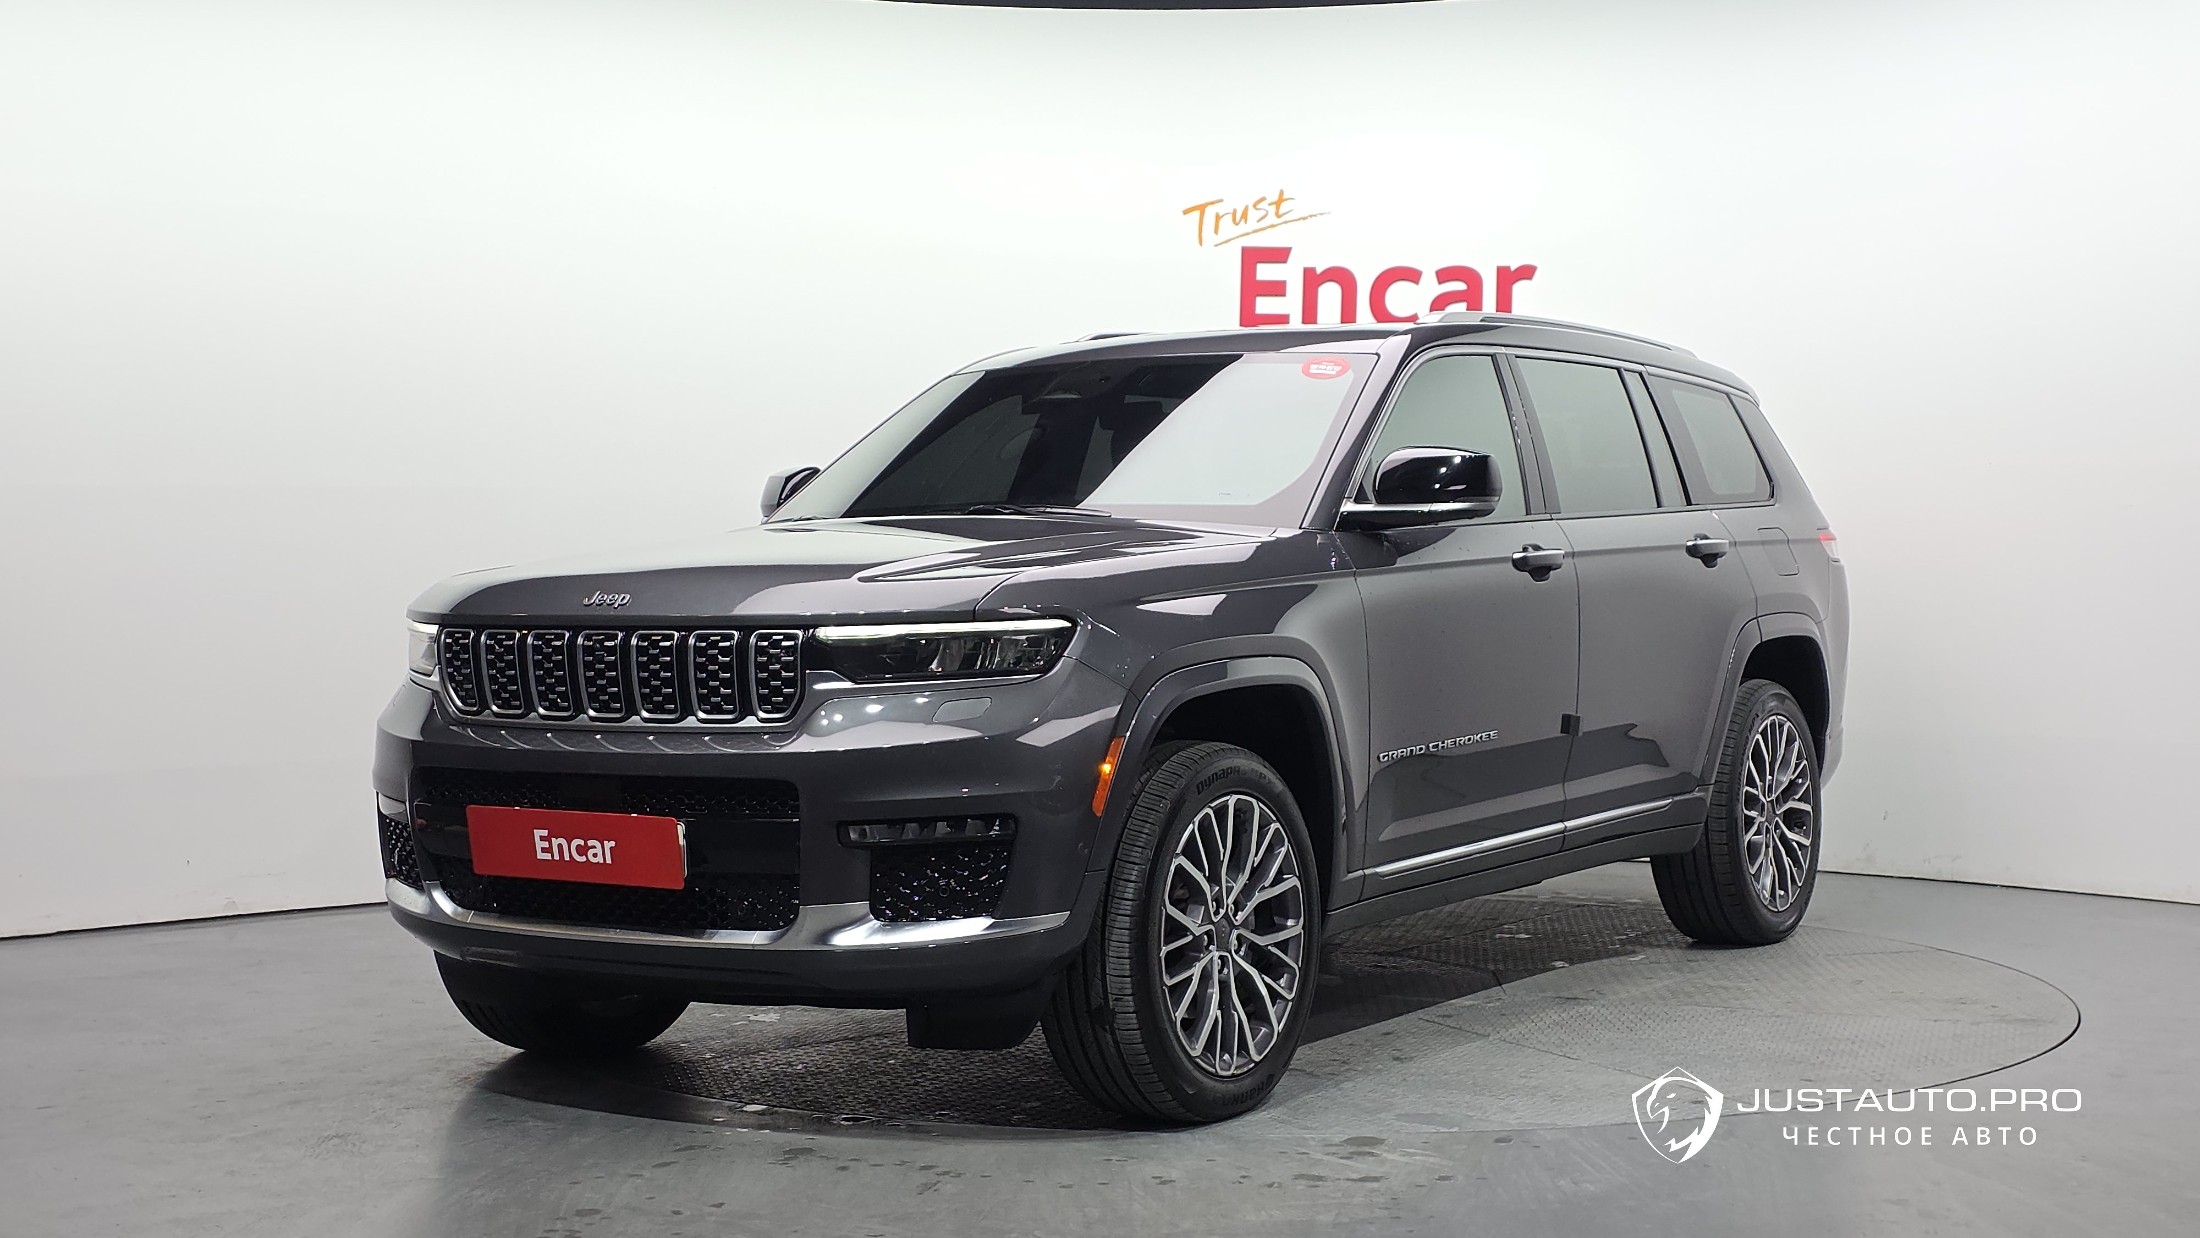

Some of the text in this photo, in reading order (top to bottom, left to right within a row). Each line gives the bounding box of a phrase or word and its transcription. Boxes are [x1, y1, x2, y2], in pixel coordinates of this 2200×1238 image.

[1182, 188, 1296, 247] Trust
[1240, 245, 1538, 328] Encar
[583, 590, 632, 609] Jeep
[1378, 730, 1499, 763] GRAND CHEROKEE
[533, 829, 616, 865] Encar
